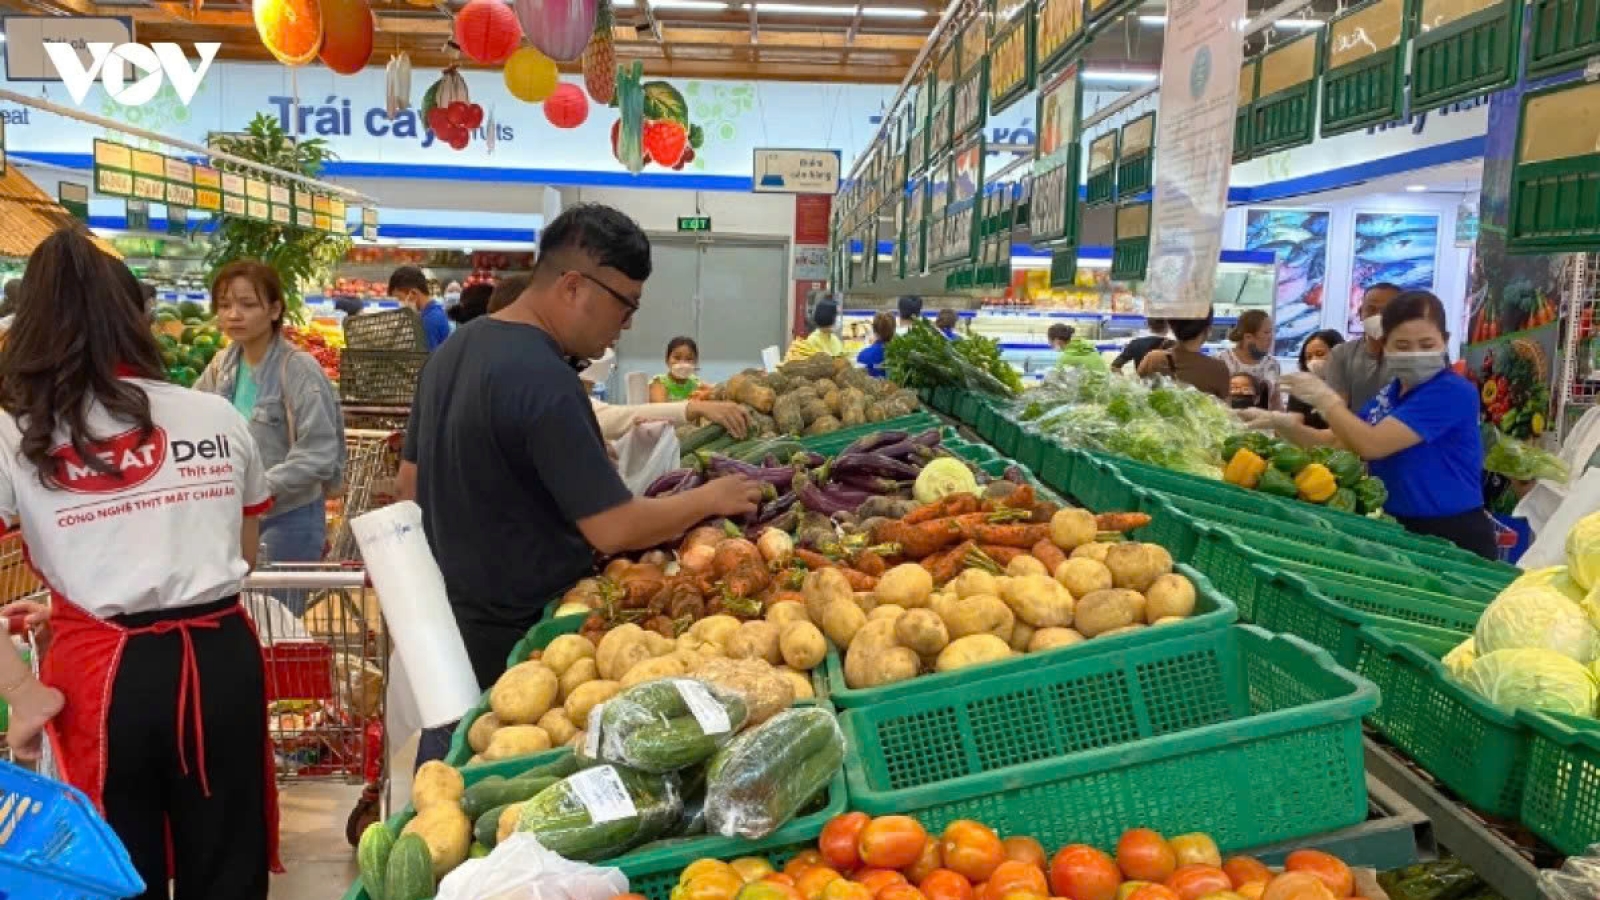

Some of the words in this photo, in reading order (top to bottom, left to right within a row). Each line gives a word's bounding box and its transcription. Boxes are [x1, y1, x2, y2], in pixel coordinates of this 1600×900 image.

[268, 96, 352, 136] Trái
[170, 433, 230, 462] Deli
[58, 511, 95, 527] CÔNG
